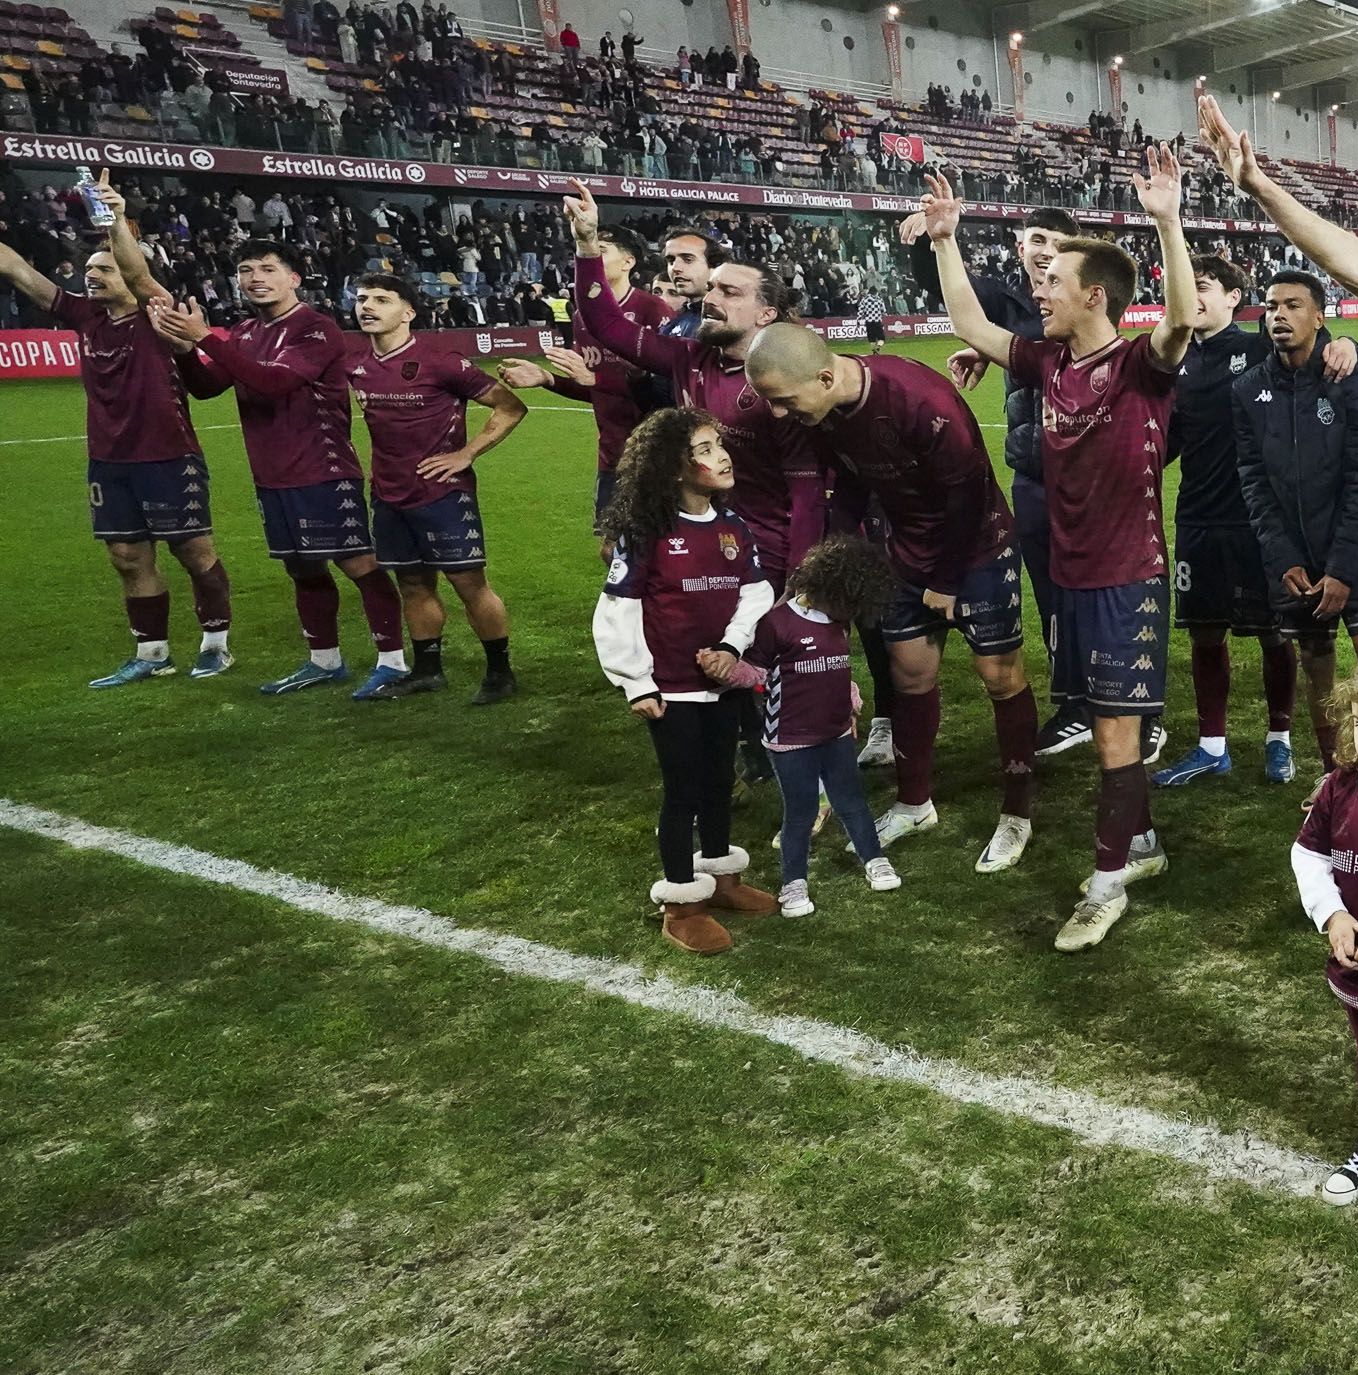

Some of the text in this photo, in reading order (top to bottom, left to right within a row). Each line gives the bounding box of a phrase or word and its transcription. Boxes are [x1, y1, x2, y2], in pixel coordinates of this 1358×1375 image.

[4, 137, 186, 168] Estrella Galicia
[262, 156, 403, 181] Estrella Galicia
[639, 187, 739, 202] HOTEL GALICIA PALACE
[763, 190, 793, 204] Diario
[802, 193, 853, 208] Pontevedra
[872, 198, 898, 210] Diario
[1124, 214, 1140, 224] Diario
[1125, 311, 1163, 322] MAPFRE
[828, 326, 867, 339] PESCAM
[916, 323, 953, 334] PESCAM
[0, 341, 57, 367] COPA
[1058, 404, 1110, 426] Deputaón
[826, 655, 849, 663] DEPUT
